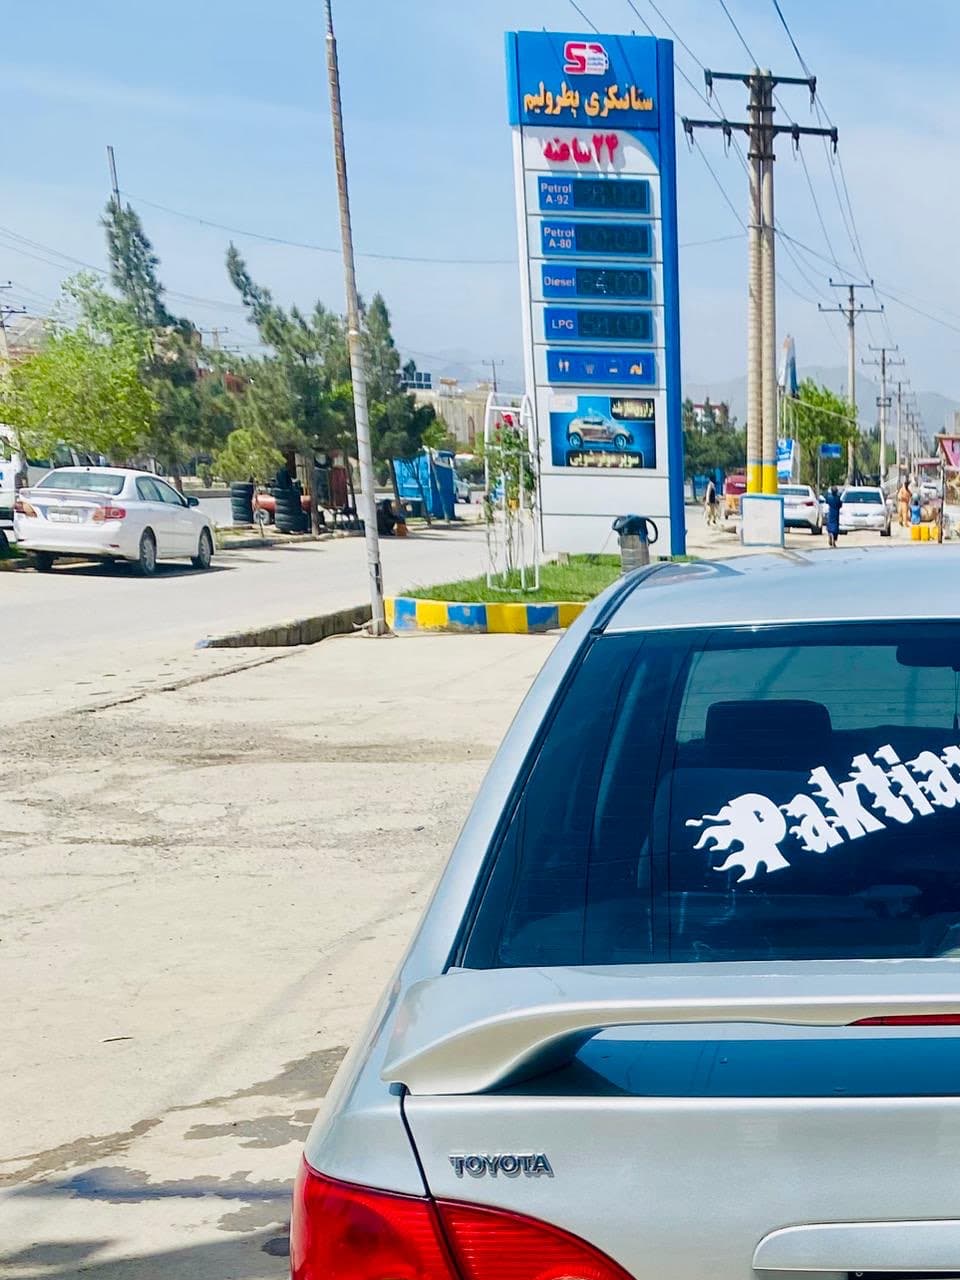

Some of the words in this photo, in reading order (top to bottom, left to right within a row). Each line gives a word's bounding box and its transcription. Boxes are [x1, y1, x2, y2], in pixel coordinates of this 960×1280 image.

[541, 182, 572, 193] Petrol
[545, 195, 569, 205] A-92
[543, 227, 575, 238] Petrol
[549, 239, 572, 249] A-80
[543, 276, 576, 287] Diesel
[551, 319, 574, 330] LPG
[449, 1152, 554, 1177] TOYOTA
